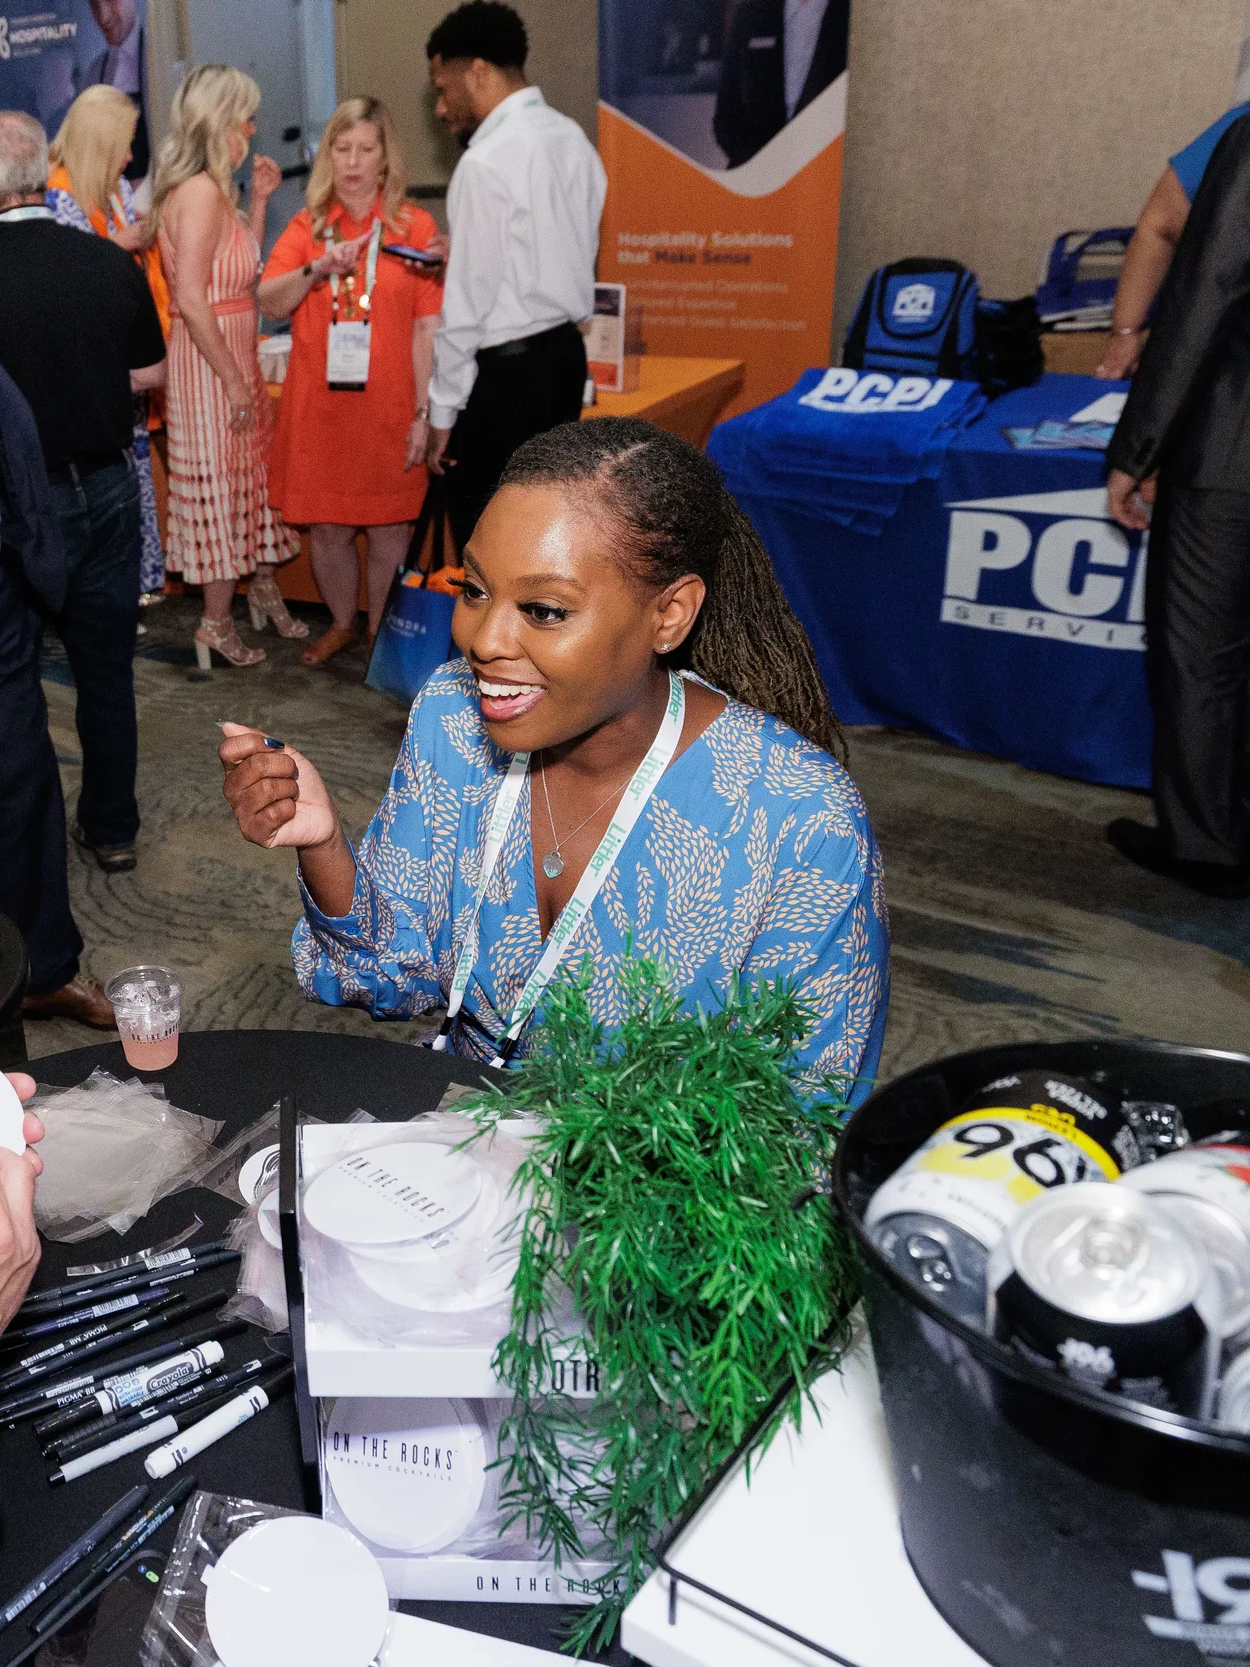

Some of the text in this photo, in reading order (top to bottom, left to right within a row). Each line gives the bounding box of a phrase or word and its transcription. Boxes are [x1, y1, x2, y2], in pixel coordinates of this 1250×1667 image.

[617, 231, 794, 250] Hospitality Solutions
[617, 250, 753, 265] that Make Sense
[944, 511, 1148, 621] PC
[628, 745, 670, 802] Littler
[489, 790, 517, 844] Littler
[589, 822, 626, 878] Littler
[553, 897, 586, 951] Littler
[517, 968, 547, 1012] Little
[347, 1157, 444, 1217] ON THE ROCKS
[83, 1324, 108, 1341] PIGMA
[150, 1364, 191, 1390] Crayola
[56, 1391, 82, 1406] PIGMA
[333, 1431, 453, 1470] ON THE ROCKS
[476, 1576, 499, 1591] ON
[515, 1577, 551, 1592] THE
